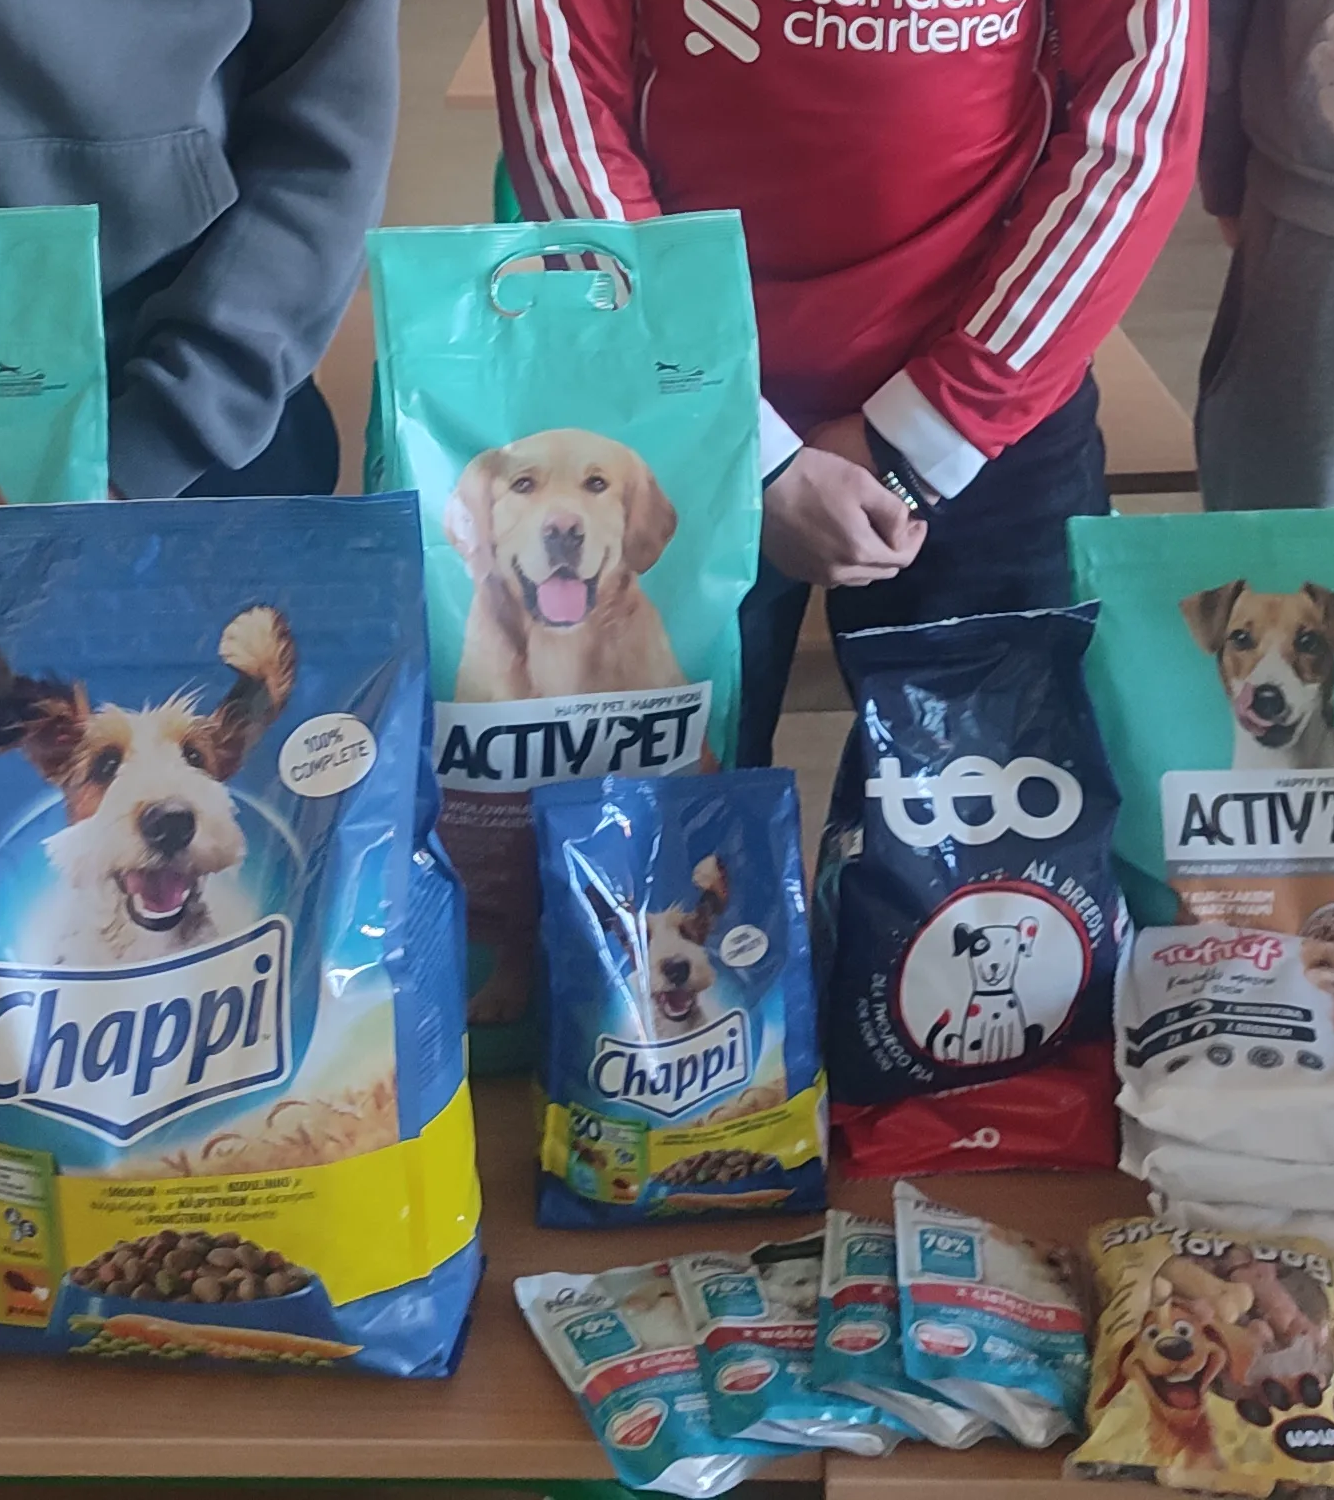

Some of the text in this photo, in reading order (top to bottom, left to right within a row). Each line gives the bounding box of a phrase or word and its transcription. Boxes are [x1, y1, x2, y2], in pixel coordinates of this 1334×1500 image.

[783, 0, 1024, 53] chartered
[288, 740, 371, 785] COMPLETE
[302, 727, 345, 752] 100%
[866, 755, 1084, 848] teo
[1022, 858, 1106, 940] ALL BREEDS
[593, 1026, 740, 1101] Chappi
[1170, 1231, 1234, 1257] for
